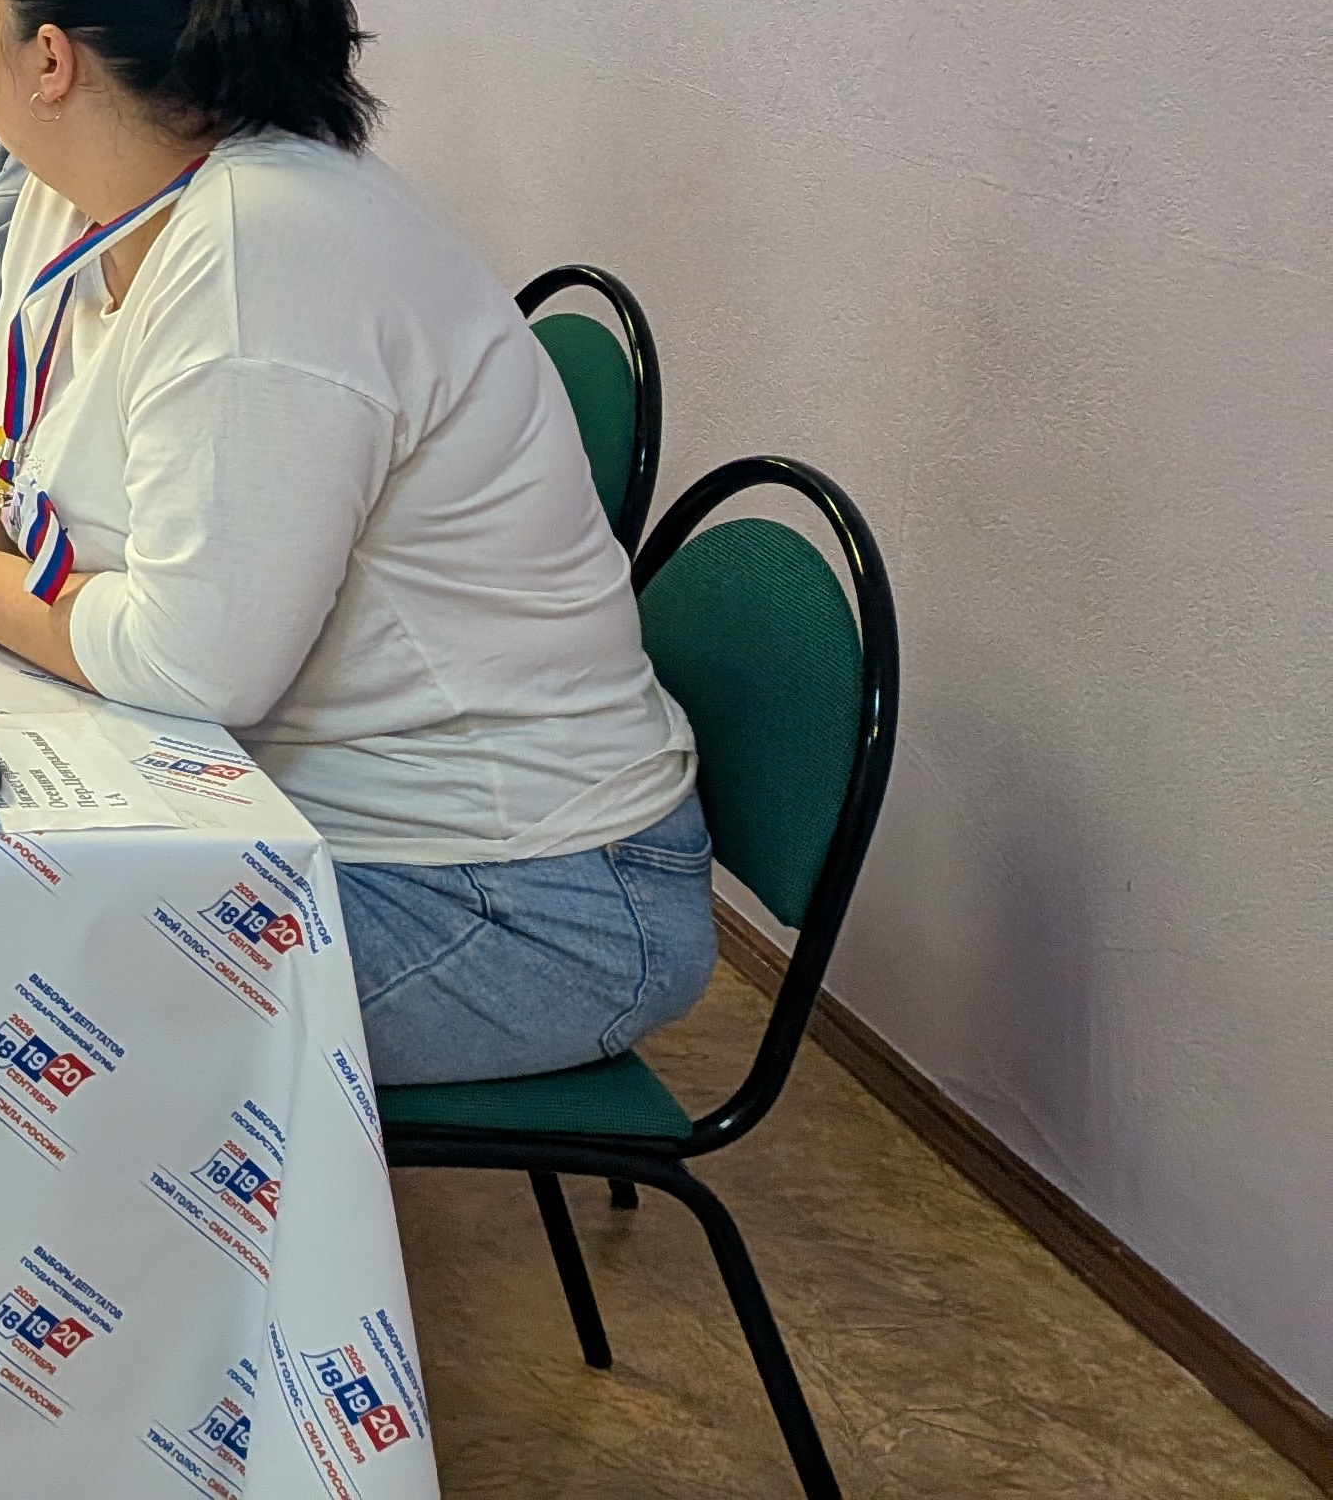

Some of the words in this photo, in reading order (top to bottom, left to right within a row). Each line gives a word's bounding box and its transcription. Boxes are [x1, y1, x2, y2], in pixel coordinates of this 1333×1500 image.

[8, 1013, 34, 1036] 2026
[14, 983, 94, 1056] ГОСУДАРСТВЕННОЙ
[88, 1044, 115, 1072] ДУМЫ
[28, 973, 74, 1014] ВЫБОРЫ
[69, 1011, 124, 1058] ДЕПУТАТОВ
[21, 1044, 47, 1070] 19
[48, 1058, 81, 1086] 20
[6, 1063, 57, 1114] СЕНТЯБРЯ
[20, 1120, 65, 1161] РОССИИ!
[343, 1343, 368, 1375] 2026
[316, 1356, 343, 1387] 18
[344, 1384, 371, 1412] 19
[369, 1410, 398, 1444] 20
